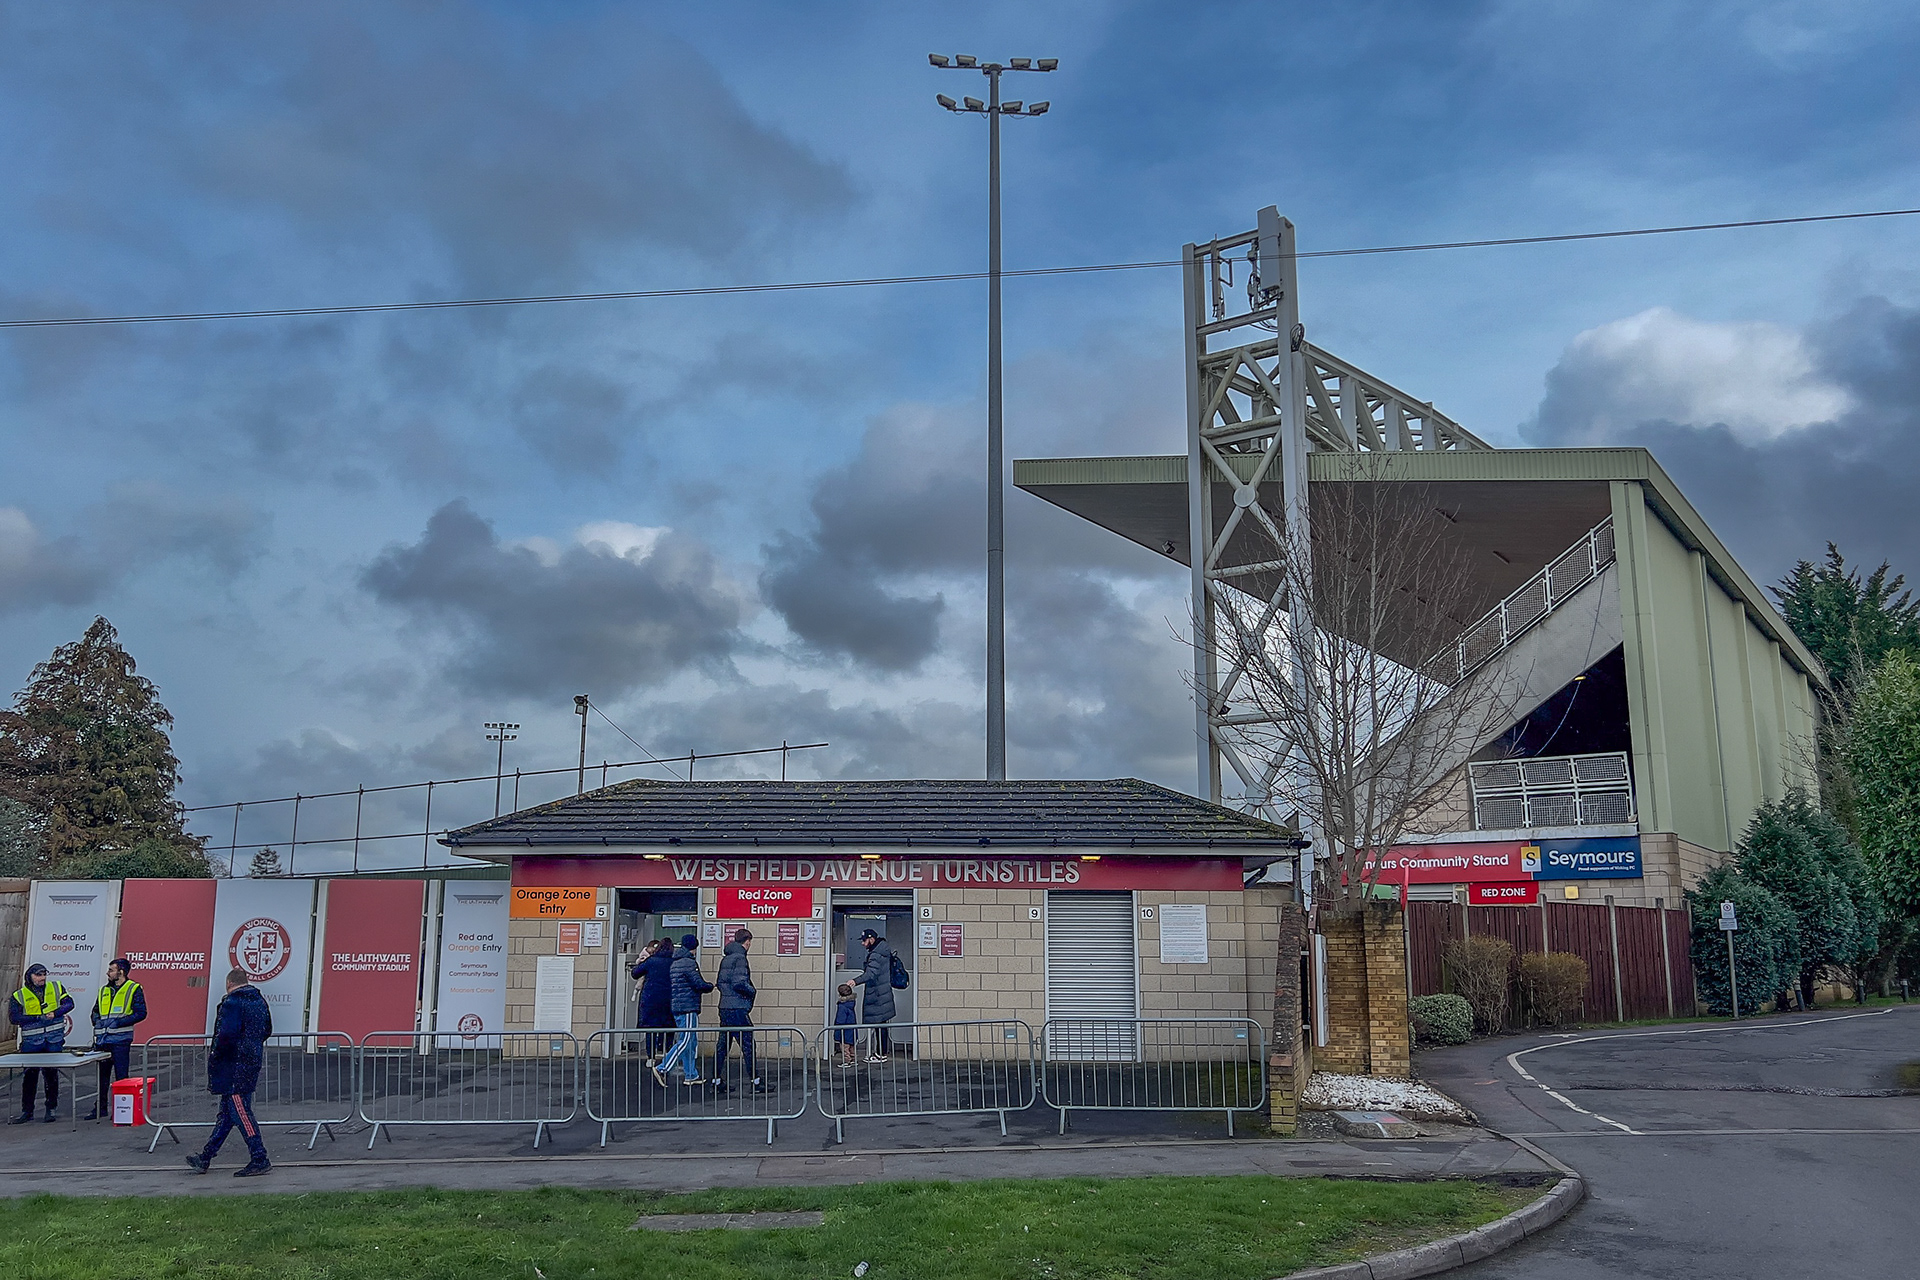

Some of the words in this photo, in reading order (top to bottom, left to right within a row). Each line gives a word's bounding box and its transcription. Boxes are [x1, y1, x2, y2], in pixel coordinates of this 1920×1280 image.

[1399, 855, 1470, 870] Community
[1473, 854, 1509, 867] Stand
[1525, 852, 1537, 866] S
[1548, 850, 1636, 869] Seymours
[670, 859, 816, 882] WESTFIELD
[819, 859, 924, 882] AVENUE
[927, 860, 1081, 884] TURNSTILES
[516, 889, 560, 902] Orange
[562, 889, 591, 900] Zone
[738, 889, 761, 900] Red
[763, 889, 792, 900] Zone
[1481, 888, 1499, 897] RED
[1500, 887, 1526, 897] ZONE
[539, 903, 567, 916] Entry
[597, 907, 605, 917] 5
[707, 907, 714, 917] 6
[751, 903, 779, 916] Entry
[814, 908, 821, 917] 7
[922, 908, 930, 918] 8
[1031, 908, 1039, 918] 9
[1141, 908, 1154, 918] 10
[244, 919, 280, 930] WOKING
[52, 933, 67, 941] Red
[69, 933, 86, 941] and
[458, 933, 475, 941] Red
[476, 933, 494, 941] and
[42, 943, 73, 953] Orange
[74, 943, 95, 953] Entry
[448, 943, 480, 953] Orange
[482, 943, 502, 953] Entry
[125, 952, 144, 961] THE
[145, 952, 205, 962] LAITHWAITE
[331, 953, 351, 963] THE
[352, 953, 411, 963] LAITHWAITE
[53, 962, 80, 970] Seymours
[130, 962, 170, 970] OMMUNITY
[170, 962, 203, 970] STADIUM
[331, 963, 377, 971] COMMUNITY
[377, 963, 410, 972] STADIUM
[46, 970, 74, 978] ommunity
[266, 965, 283, 979] CLUB
